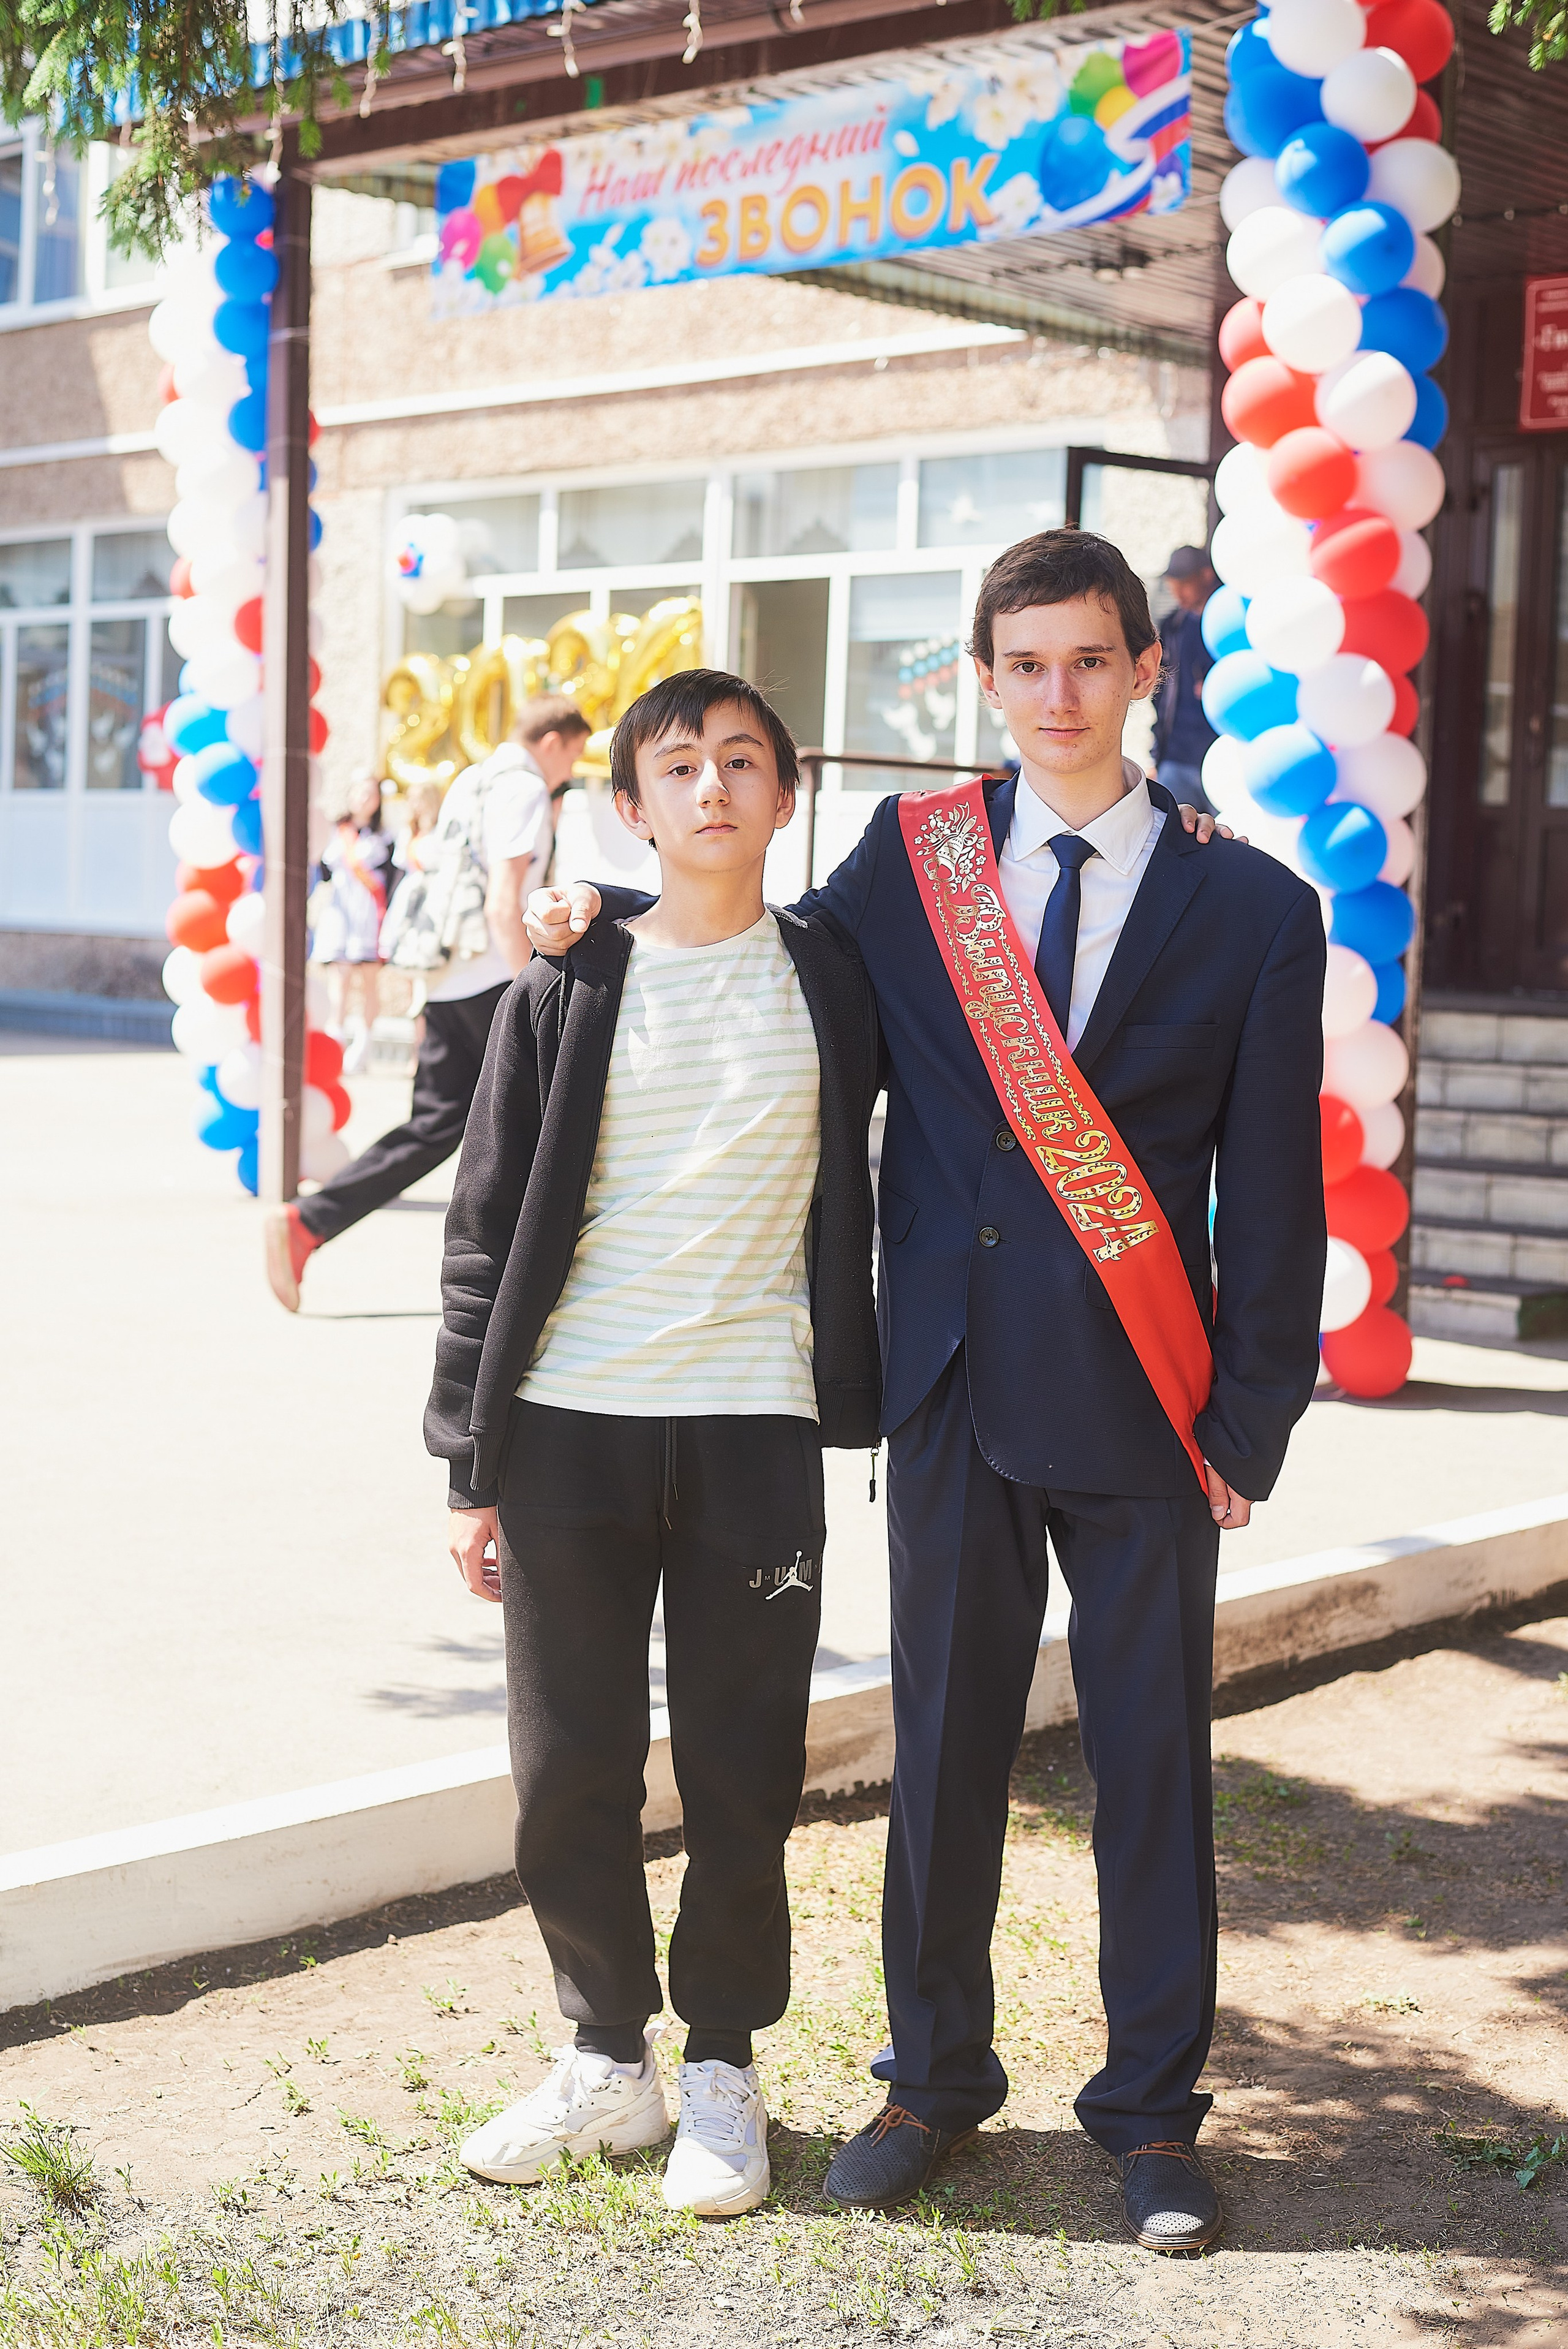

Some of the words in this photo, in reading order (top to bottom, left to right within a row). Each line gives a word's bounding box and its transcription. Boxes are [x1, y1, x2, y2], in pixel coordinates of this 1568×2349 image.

[578, 162, 668, 216] Наш
[673, 104, 889, 196] последний
[693, 153, 1002, 268] ЗВОНОК
[944, 883, 1078, 1144] Выпускник
[1034, 1129, 1160, 1264] 2024
